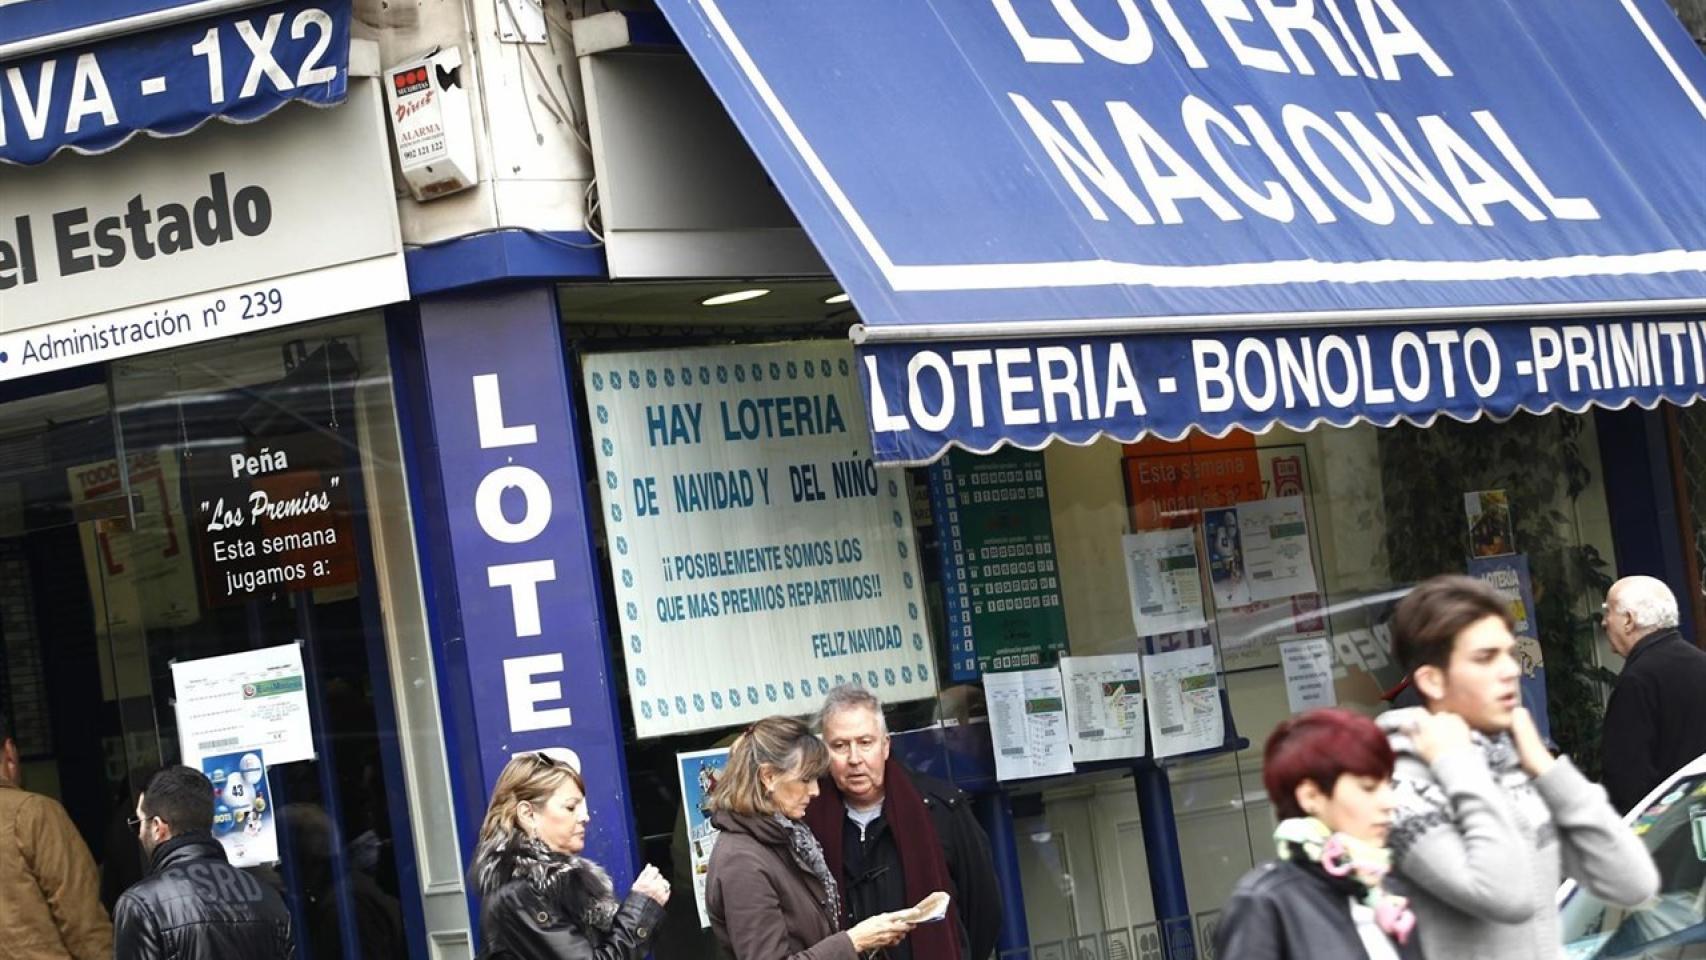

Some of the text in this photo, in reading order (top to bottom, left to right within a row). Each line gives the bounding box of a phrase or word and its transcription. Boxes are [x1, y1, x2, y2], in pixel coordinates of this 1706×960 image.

[191, 8, 338, 105] 1X2
[401, 123, 441, 142] ALARMA
[404, 141, 444, 160] 902 121 122
[1007, 92, 1601, 226] NACIONAL
[53, 172, 273, 277] Estado
[22, 288, 284, 366] Administración nº 239
[864, 342, 1147, 432] LOTERIA
[1191, 327, 1502, 412] BONOLOTO
[646, 394, 846, 447] HAY LOTERIA
[230, 448, 289, 479] Peña
[1138, 457, 1246, 485] Esta semana
[633, 450, 879, 517] DE NAVIDAD Y DEL NIÑO
[213, 528, 337, 562] Esta semana
[784, 540, 834, 570] SOMOS
[836, 537, 863, 563] LOS
[226, 559, 331, 596] jugamos a:
[656, 574, 882, 624] QUE MAS PREMIOS REPARTIMOS!!
[812, 624, 903, 659] FELIZ NAVIDAD
[231, 784, 244, 798] 43
